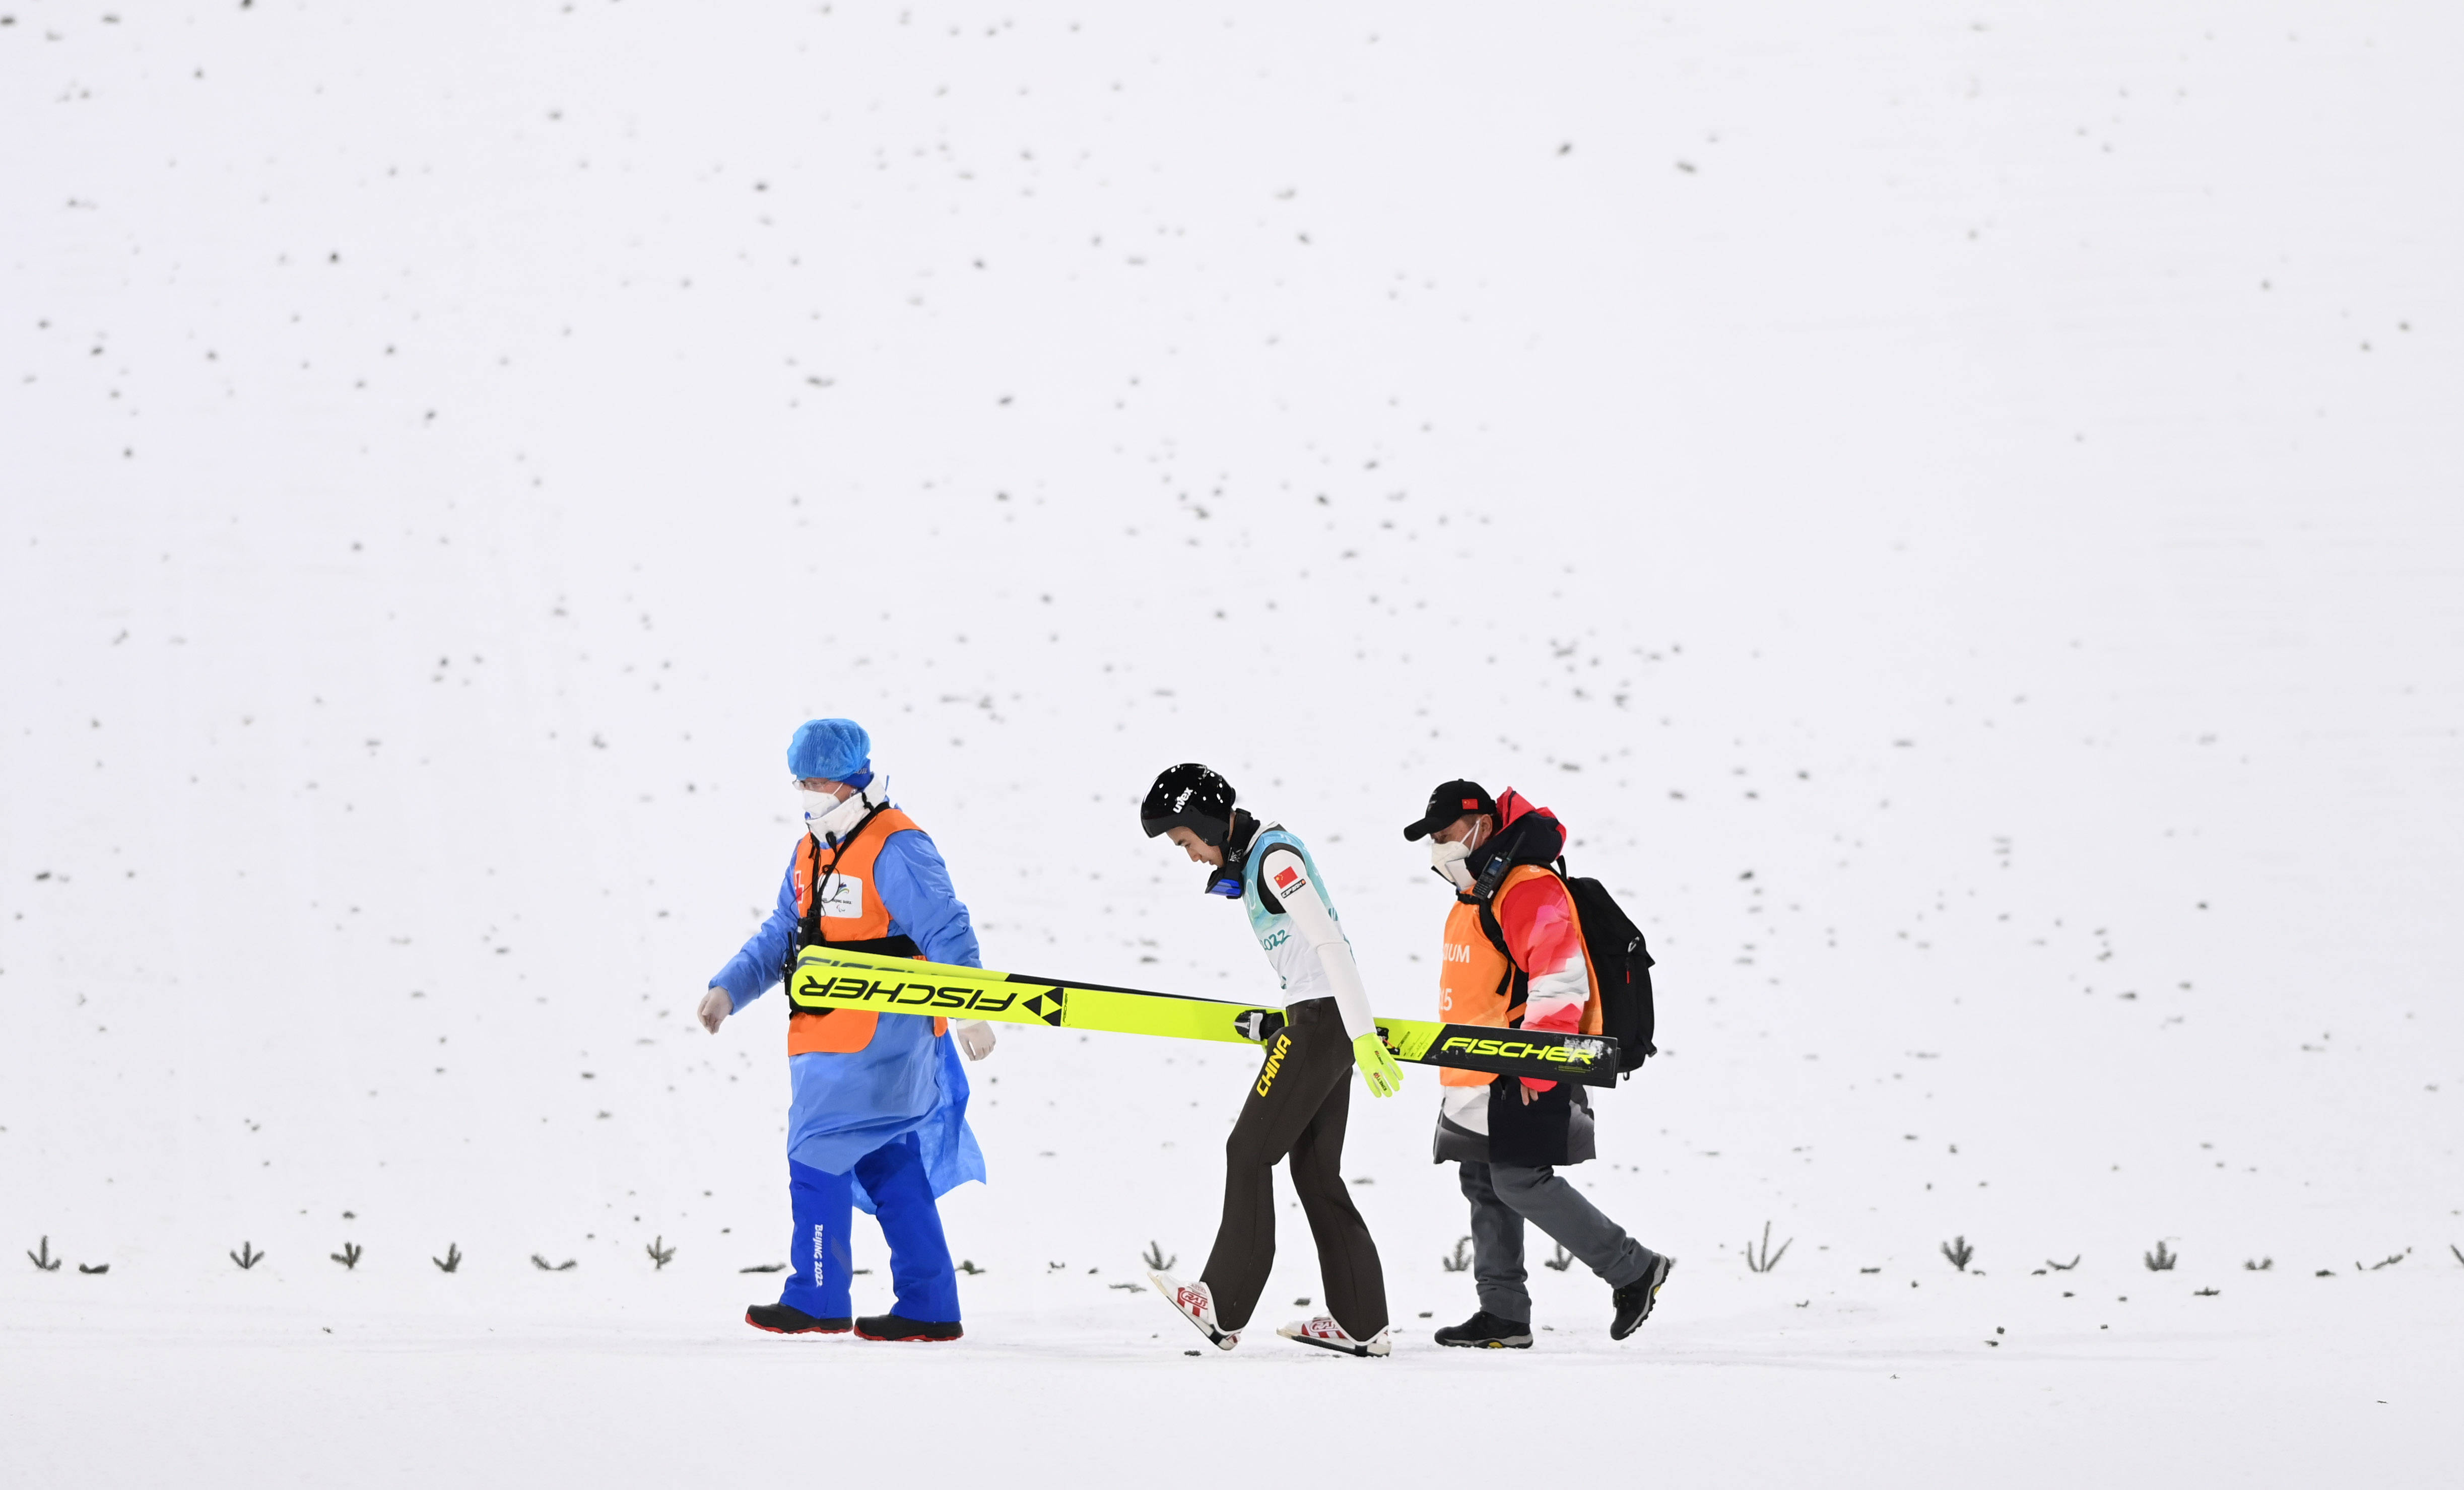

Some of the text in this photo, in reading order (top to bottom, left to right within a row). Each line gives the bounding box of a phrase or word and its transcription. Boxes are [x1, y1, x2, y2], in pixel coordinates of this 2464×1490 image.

[1173, 786, 1193, 814] uvex
[799, 975, 1018, 1012] FISCHER
[1256, 1034, 1292, 1097] CHINA
[1441, 1037, 1596, 1064] FISCHER
[813, 1224, 824, 1288] BEIJING 2022
